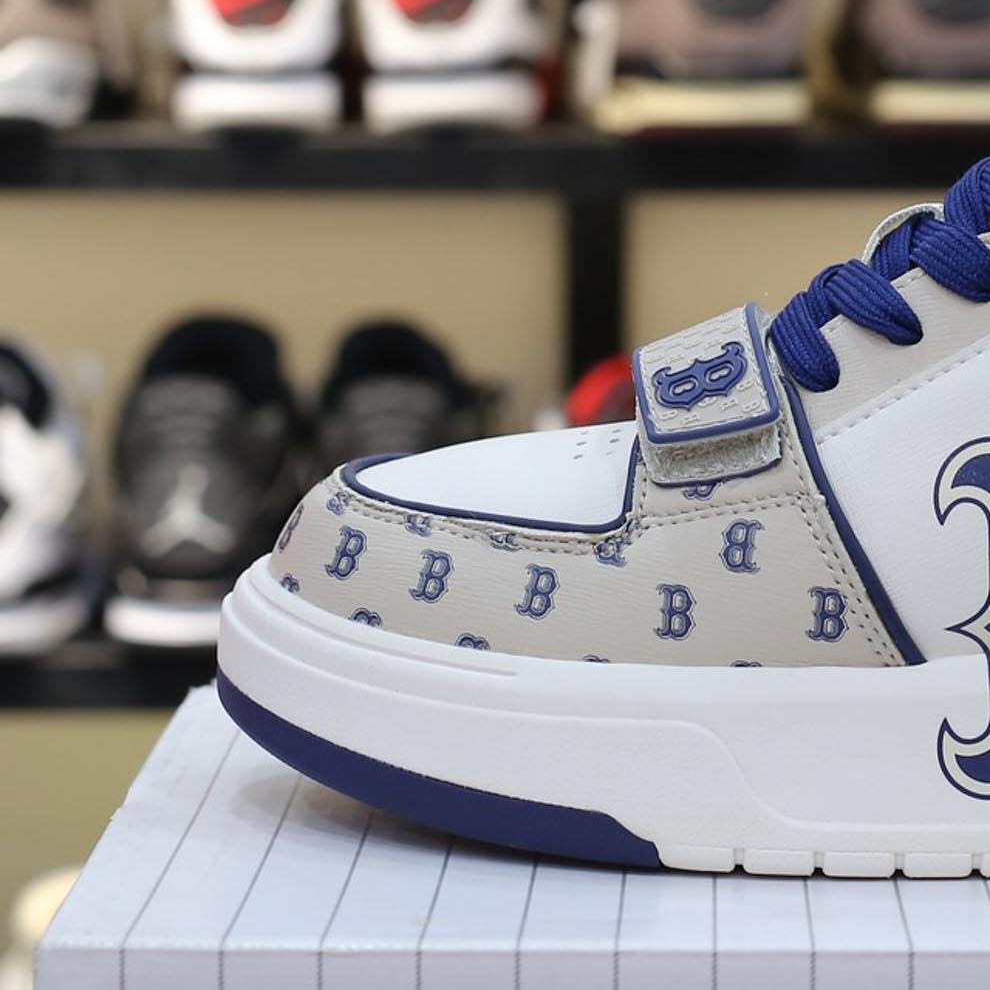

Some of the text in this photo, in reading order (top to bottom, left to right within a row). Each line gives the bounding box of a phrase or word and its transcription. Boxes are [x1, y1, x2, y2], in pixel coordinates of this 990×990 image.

[651, 341, 748, 412] B
[324, 525, 367, 581] B
[719, 519, 765, 574] B
[408, 548, 455, 604] B
[514, 563, 560, 621] B
[653, 584, 697, 641] B
[805, 586, 850, 642] B
